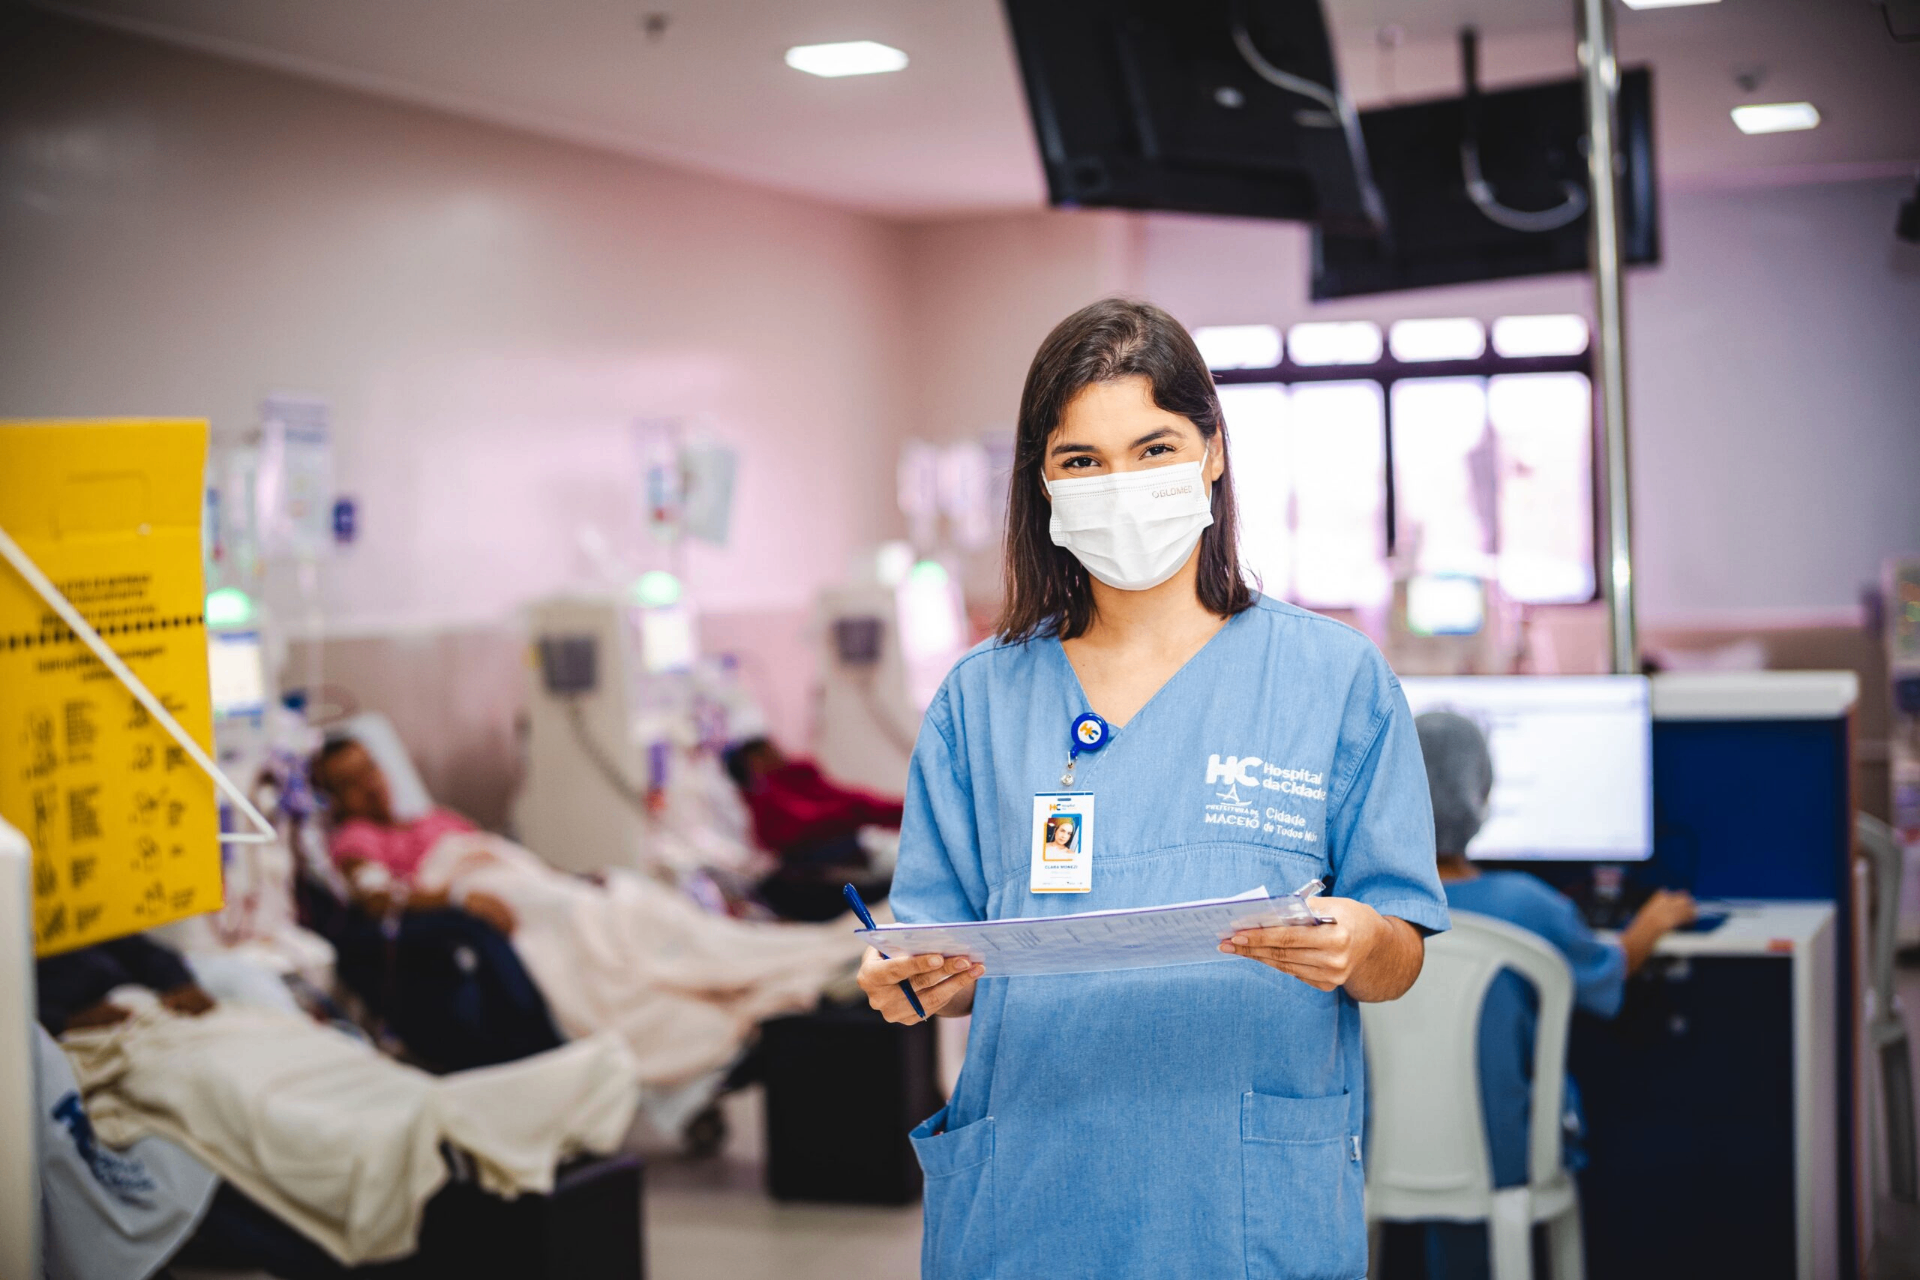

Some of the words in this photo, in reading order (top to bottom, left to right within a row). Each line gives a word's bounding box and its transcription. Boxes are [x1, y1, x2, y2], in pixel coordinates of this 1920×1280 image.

[1206, 754, 1263, 786] HC
[1263, 761, 1323, 785] Hospital
[1205, 813, 1259, 828] MACEIÓ
[1266, 807, 1305, 826] Cidade
[1263, 822, 1275, 833] de
[1275, 824, 1304, 839] Todos
